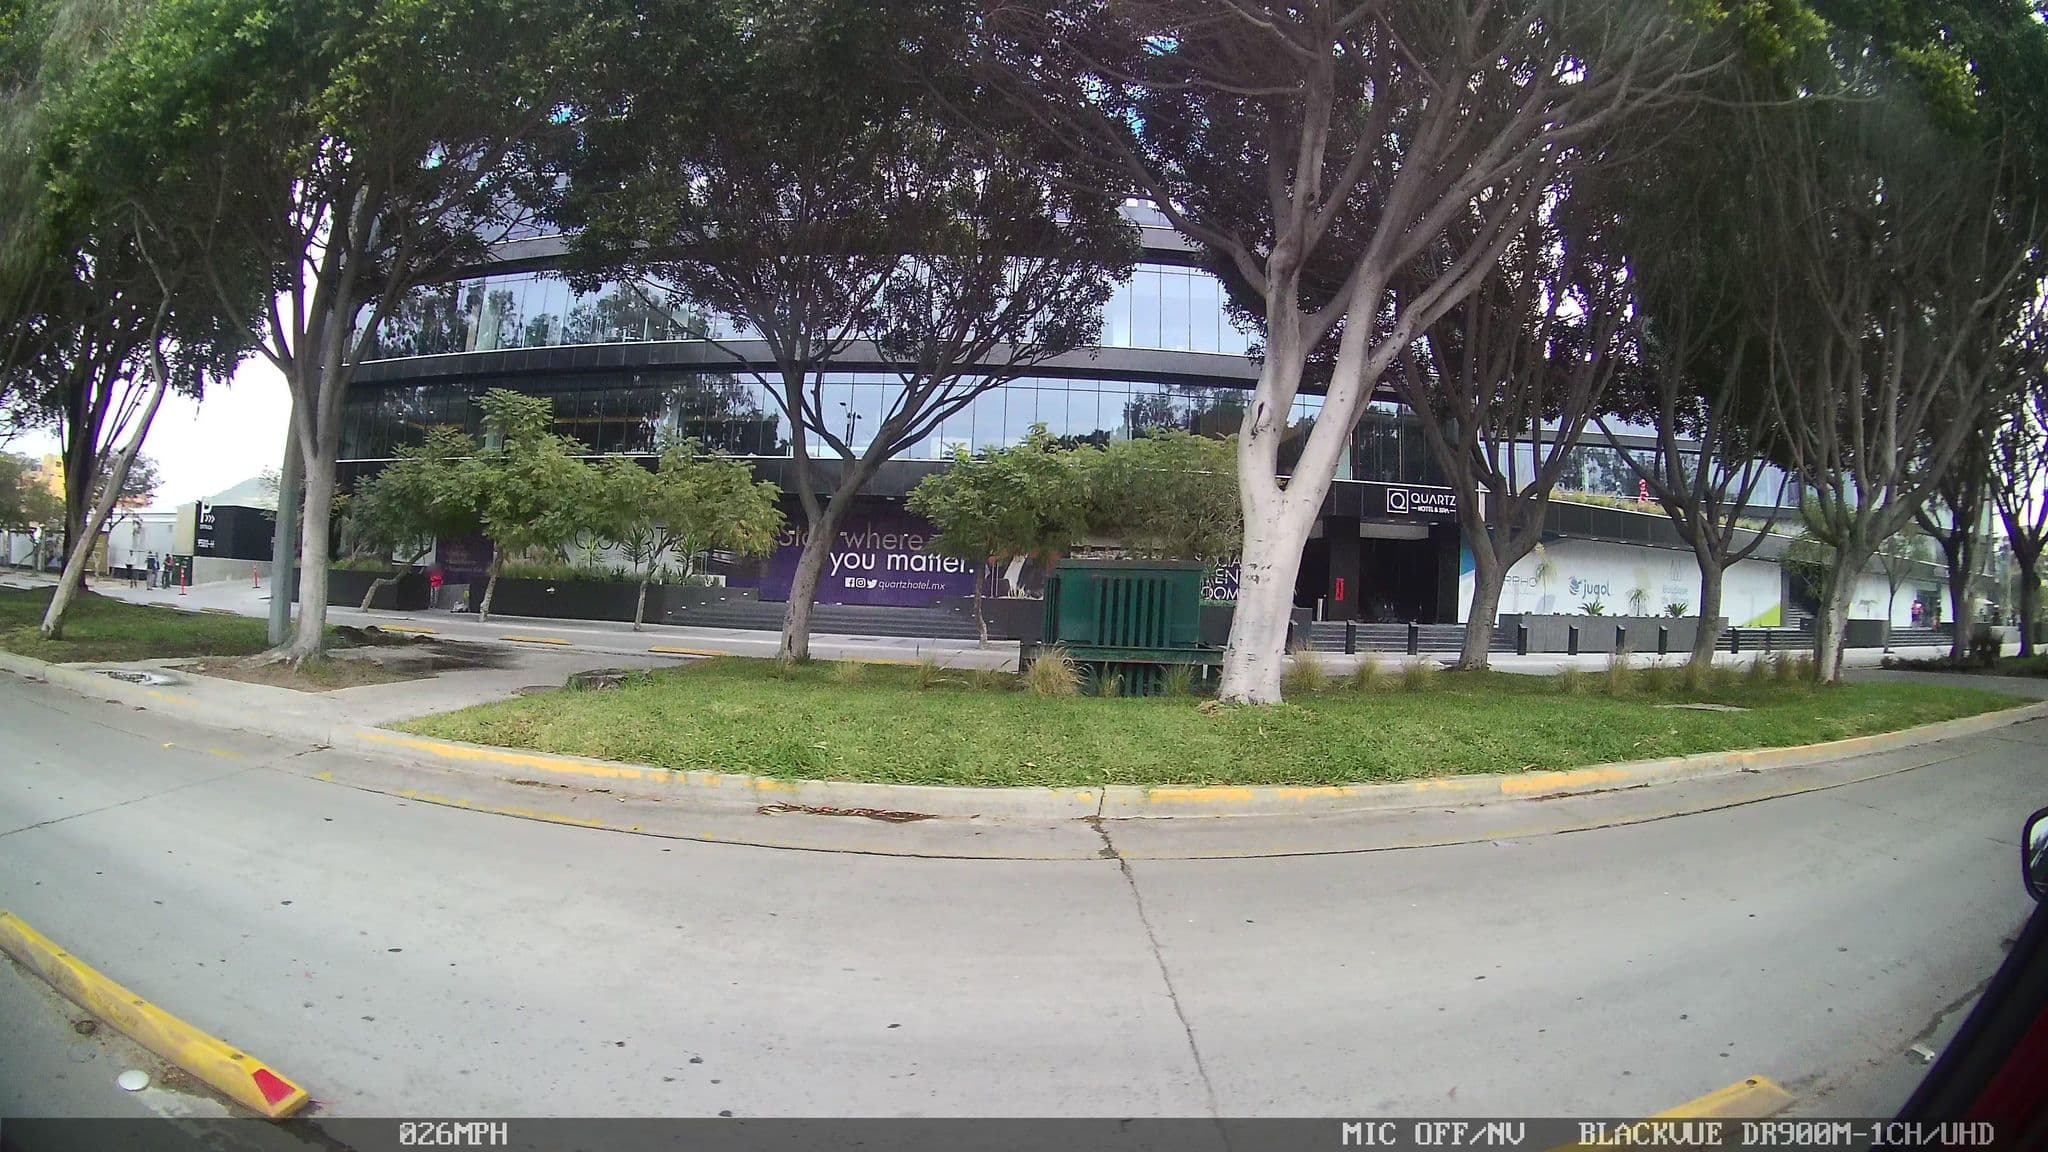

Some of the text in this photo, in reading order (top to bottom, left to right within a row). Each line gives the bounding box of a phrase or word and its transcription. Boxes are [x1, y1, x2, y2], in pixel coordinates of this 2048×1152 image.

[1410, 492, 1456, 506] QUARTZ
[200, 500, 212, 523] P
[842, 521, 923, 550] where
[829, 552, 875, 577] you
[878, 579, 946, 591] quartzhotel.mx
[1582, 579, 1611, 600] jugol
